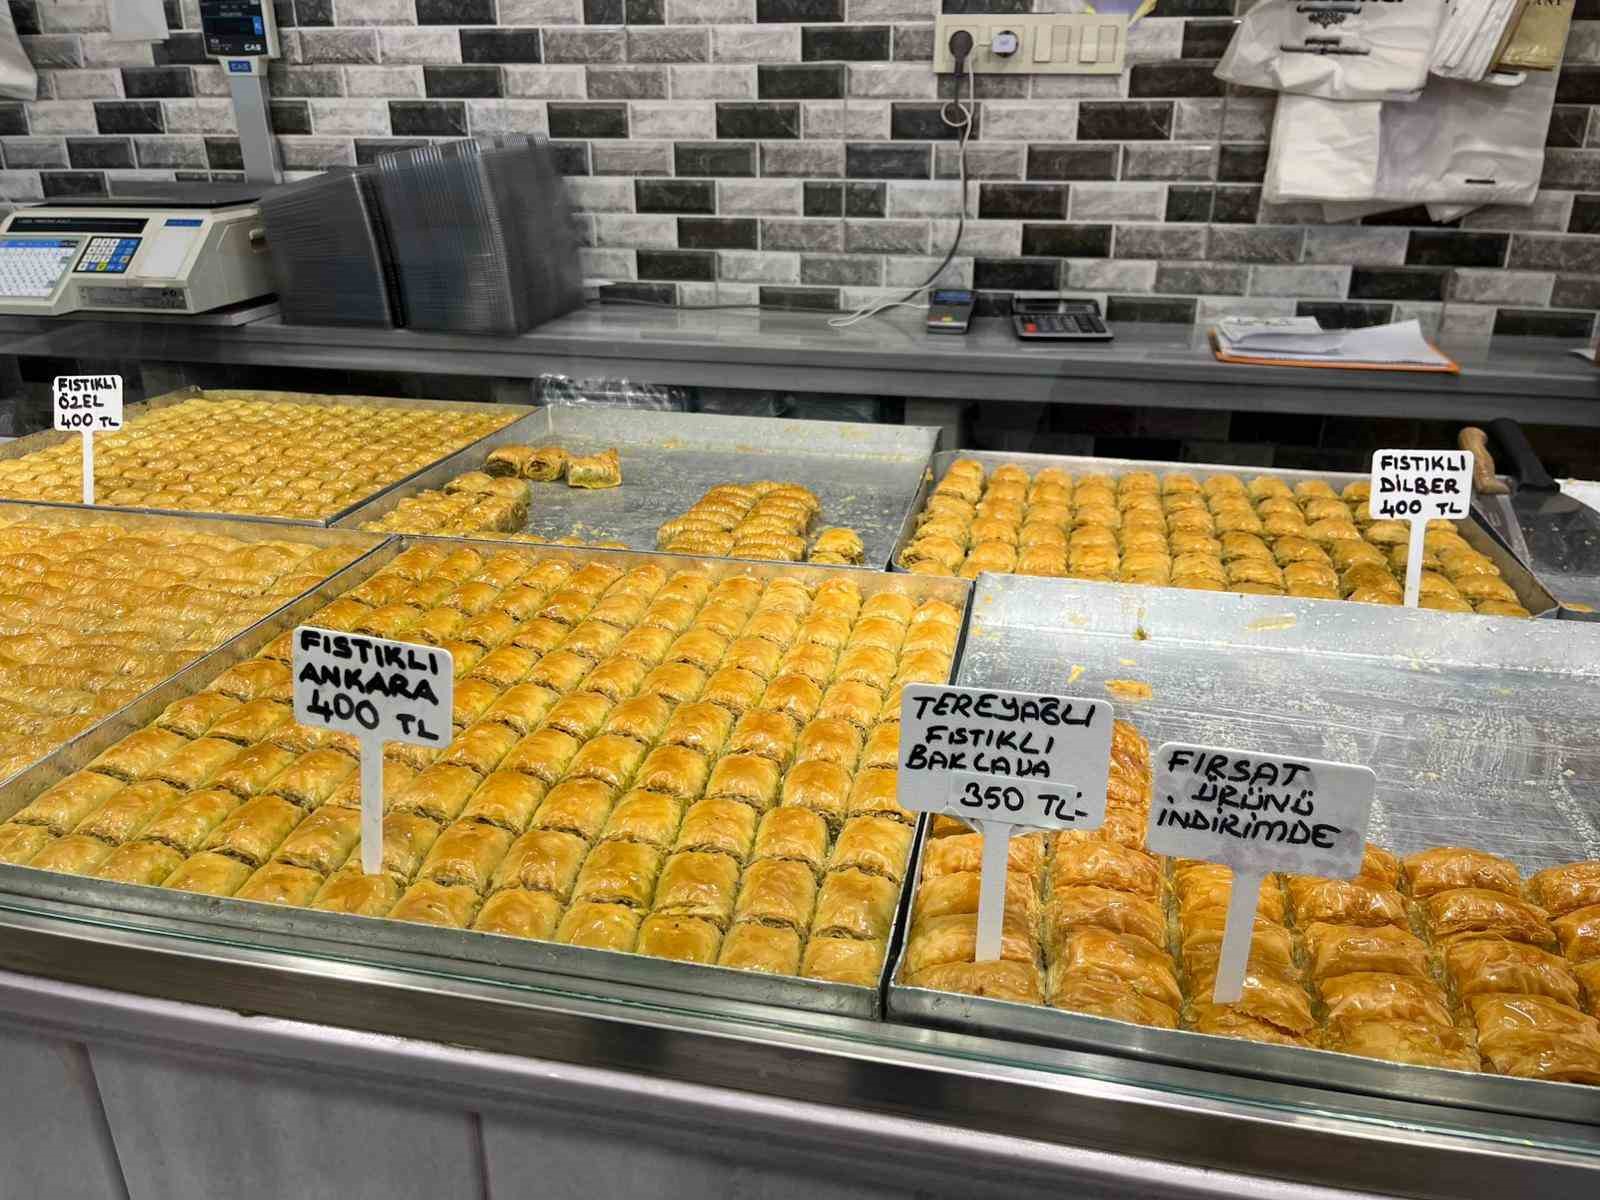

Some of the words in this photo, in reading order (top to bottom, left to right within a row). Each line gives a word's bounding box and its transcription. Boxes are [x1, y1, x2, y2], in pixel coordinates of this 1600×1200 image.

[57, 376, 117, 392] FISTIKLI
[60, 412, 94, 429] 400
[98, 415, 120, 428] TL
[1380, 455, 1467, 472] FISTIKLI
[1379, 474, 1461, 496] DİLBER
[1379, 498, 1422, 519] 400
[1435, 501, 1463, 516] TL
[300, 629, 439, 676] FISTIKLI
[298, 661, 440, 706] ANKARA
[306, 688, 380, 730] 400
[395, 712, 440, 742] TL
[924, 724, 1056, 756] FISTIKLI
[1167, 749, 1311, 787] FIRSAT
[959, 781, 1026, 812] 350
[1190, 773, 1315, 818] ÜRÜNÜ
[1156, 794, 1343, 850] İNDİRİMDE
